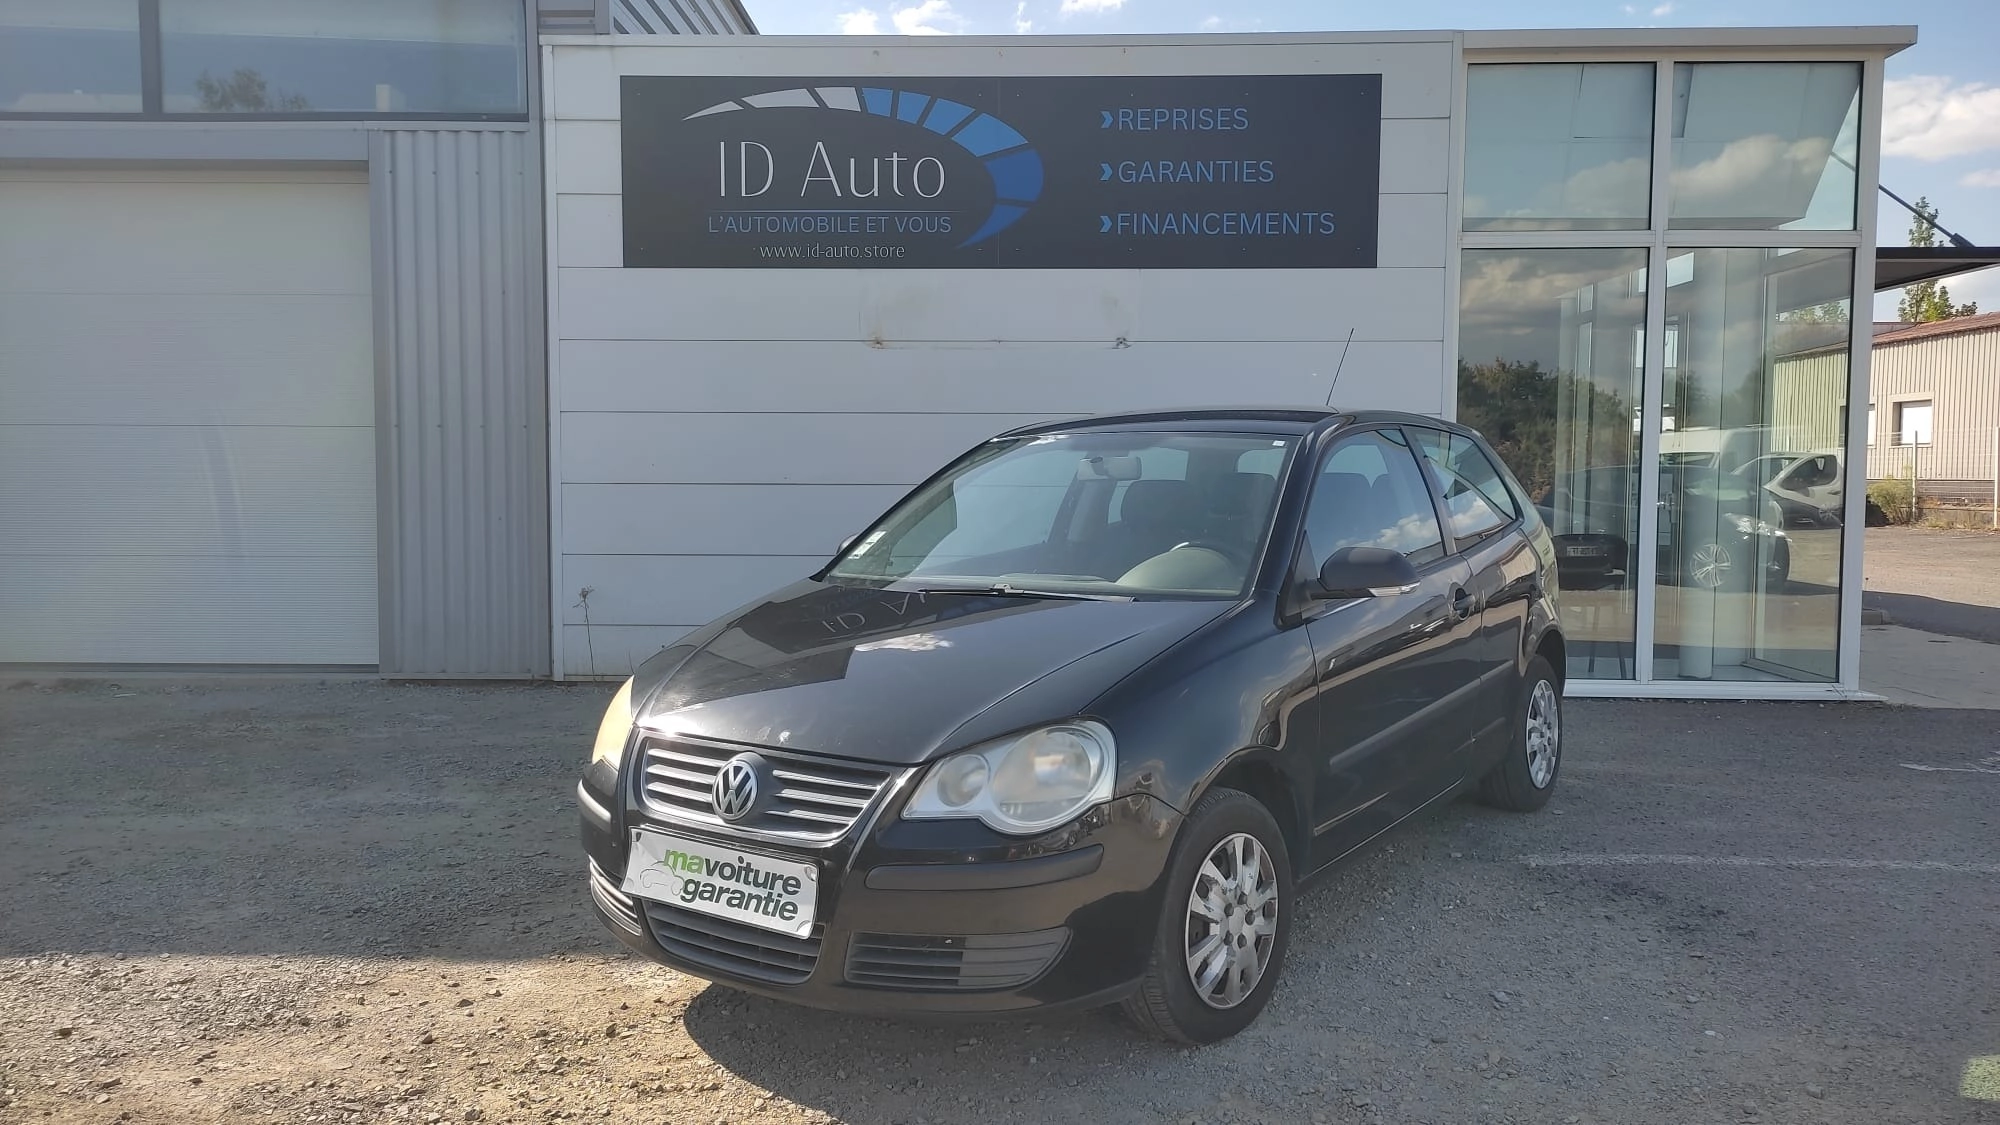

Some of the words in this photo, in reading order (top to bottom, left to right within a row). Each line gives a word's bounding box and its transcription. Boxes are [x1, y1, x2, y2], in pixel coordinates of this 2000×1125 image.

[1117, 107, 1249, 131] REPRISES
[719, 141, 774, 197] ID
[800, 141, 946, 198] Auto
[1117, 160, 1275, 183] GARANTIES
[708, 215, 860, 234] L'AUTOMOBILE
[865, 215, 890, 234] ET
[894, 215, 952, 234] VOUS
[1116, 211, 1336, 236] FINANCEMENTS
[759, 242, 905, 259] www.id-auto.store
[716, 761, 756, 818] VW
[663, 849, 802, 896] mavoiture
[680, 878, 799, 921] garantie
